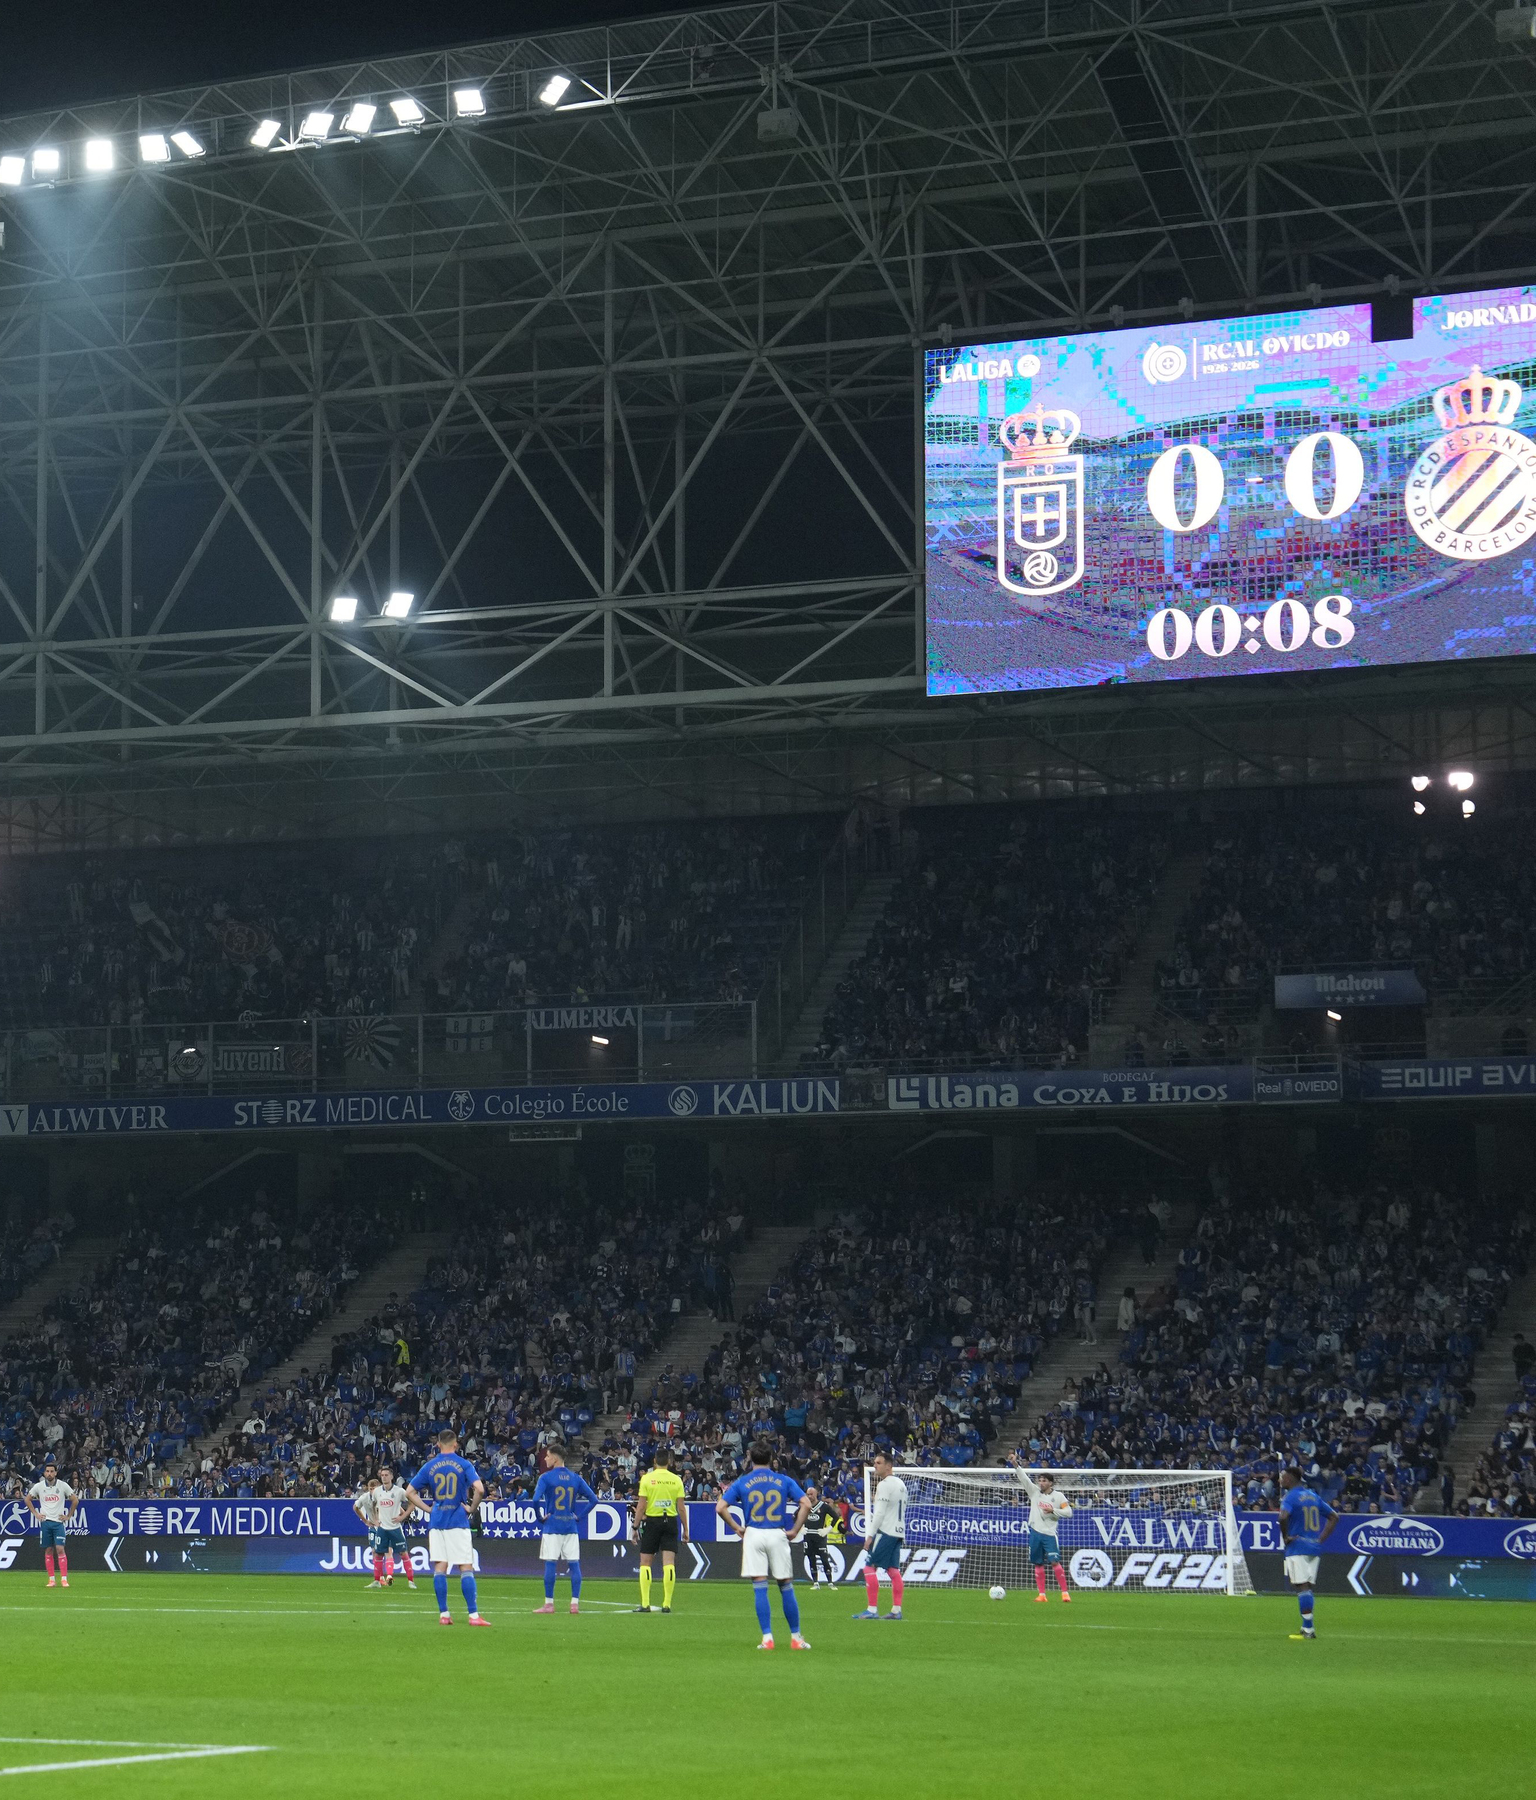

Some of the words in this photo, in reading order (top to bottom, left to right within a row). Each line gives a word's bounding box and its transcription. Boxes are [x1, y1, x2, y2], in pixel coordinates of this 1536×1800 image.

[940, 358, 1014, 384] LALIGA
[1147, 443, 1225, 532] 0
[1284, 431, 1365, 521] 0
[1147, 595, 1356, 661] 00:08
[1315, 973, 1385, 993] Mahou
[524, 1008, 637, 1030] ALIMERKA
[1103, 1072, 1155, 1083] BODEGAS
[1257, 1082, 1282, 1094] Real
[1294, 1080, 1338, 1093] OVIEDO
[1381, 1066, 1473, 1089] EQUIP
[484, 1093, 564, 1120] Colegio
[571, 1087, 630, 1113] École
[1033, 1083, 1113, 1105] COYA
[1147, 1081, 1228, 1103] HIJOS
[233, 1098, 317, 1126] STORZ
[326, 1095, 432, 1123] MEDICAL
[433, 1472, 458, 1500] 20
[554, 1486, 574, 1511] 21
[478, 1501, 545, 1524] Maho
[748, 1489, 782, 1522] 22
[1303, 1505, 1320, 1531] 10
[107, 1506, 201, 1535] STORZ
[211, 1506, 330, 1536] MEDICAL
[909, 1519, 959, 1533] GRUPO
[961, 1520, 1030, 1534] PACHUCA
[1091, 1516, 1285, 1550] VALWIVE
[1355, 1530, 1437, 1550] ASTURIANA
